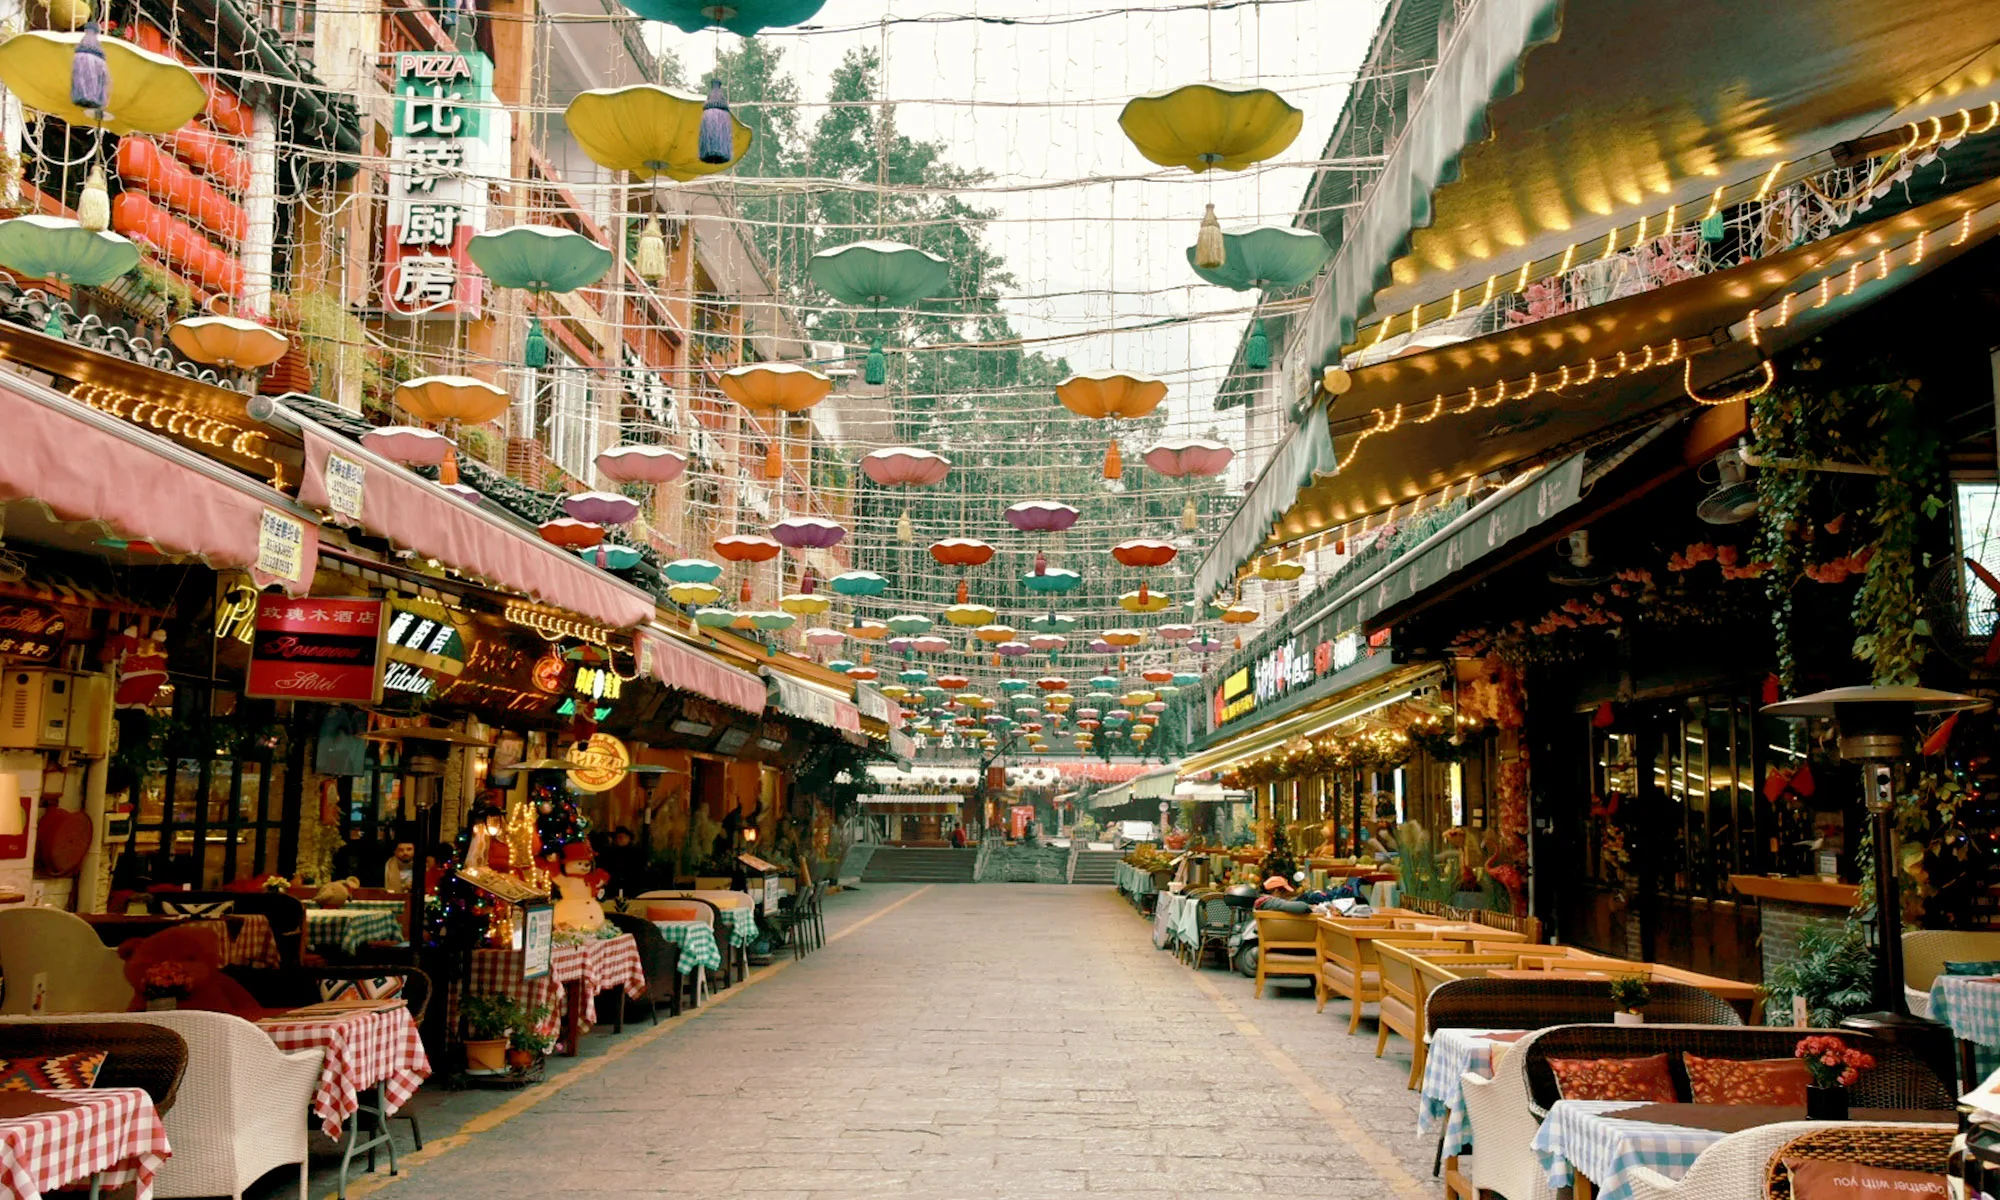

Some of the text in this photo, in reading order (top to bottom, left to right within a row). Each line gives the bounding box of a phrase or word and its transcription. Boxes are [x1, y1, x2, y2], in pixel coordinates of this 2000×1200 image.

[400, 55, 471, 77] PIZZA
[395, 85, 464, 303] 比萨厨房
[262, 606, 377, 624] 玫瑰木酒店
[275, 671, 346, 691] Hotel
[383, 662, 435, 694] Kitchen
[571, 751, 623, 771] PIZZA
[1833, 1176, 1945, 1195] ogether with you
